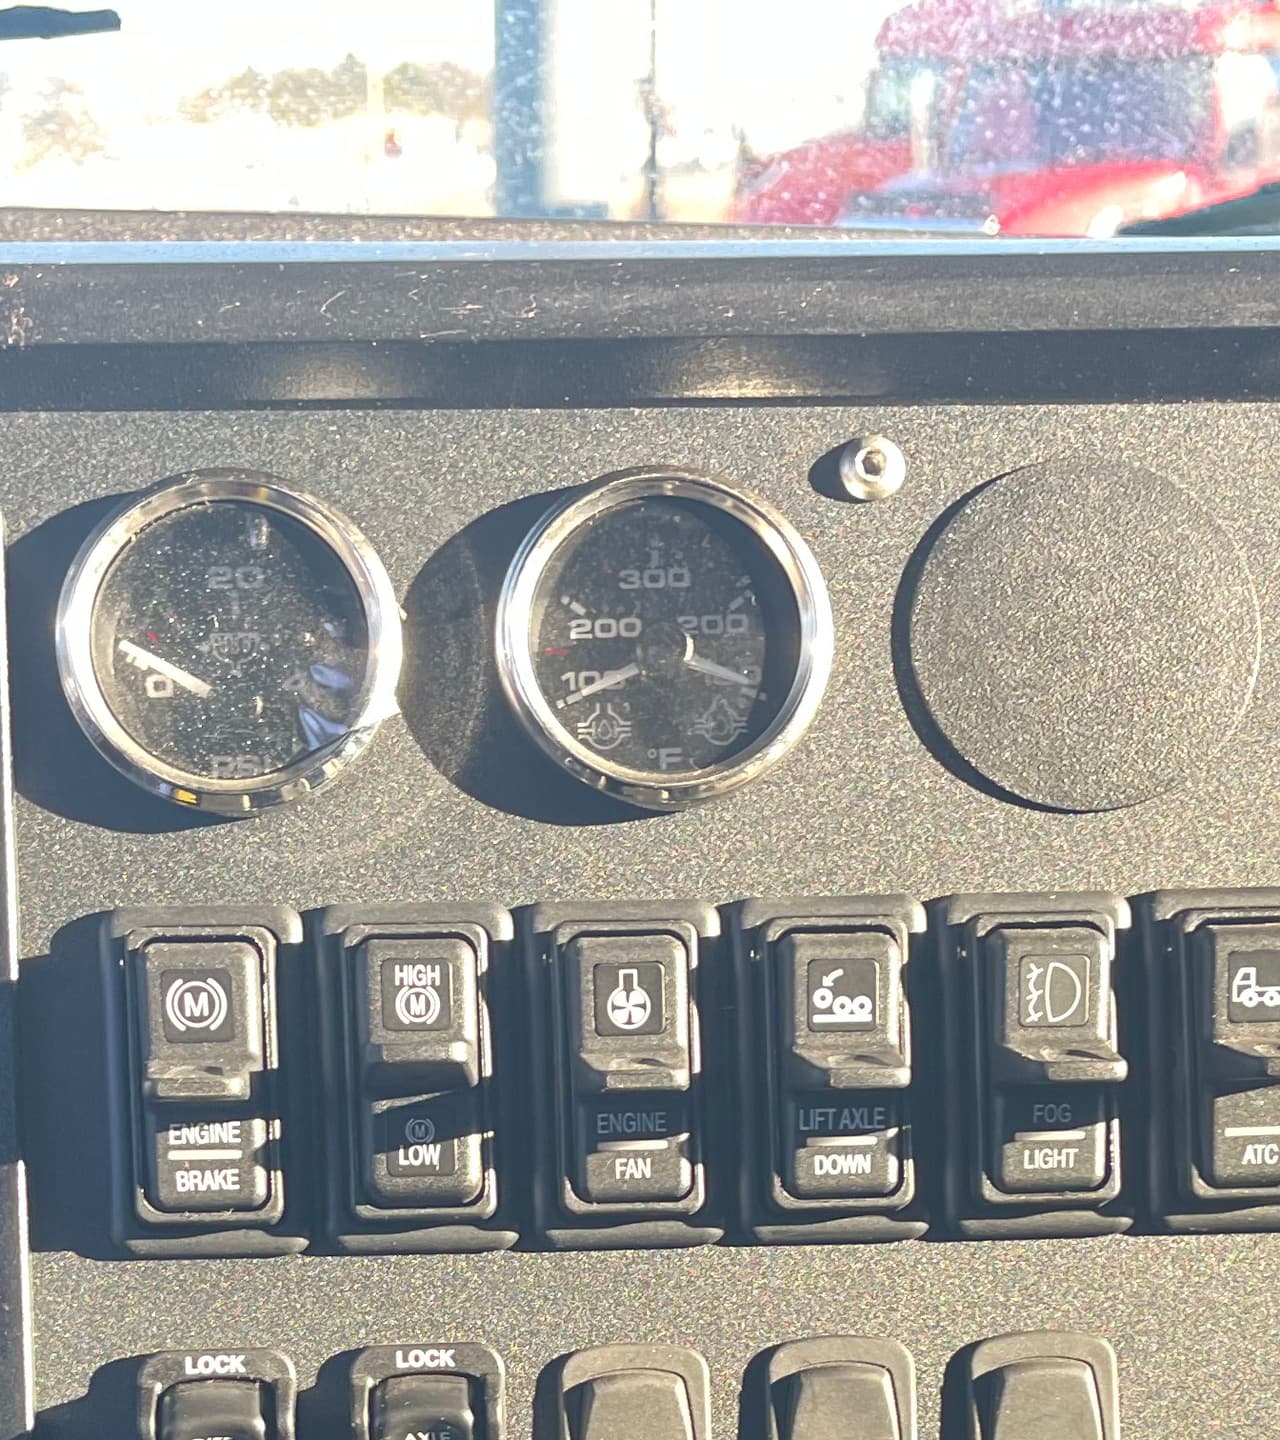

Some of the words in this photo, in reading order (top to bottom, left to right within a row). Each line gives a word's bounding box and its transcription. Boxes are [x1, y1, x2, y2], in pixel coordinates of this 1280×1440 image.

[619, 569, 691, 589] 300
[569, 617, 642, 639] 200
[677, 614, 748, 634] 200
[394, 966, 440, 986] HIGH
[184, 993, 208, 1016] M
[597, 1112, 667, 1134] ENGINE
[800, 1109, 836, 1131] LIFT
[838, 1108, 885, 1130] AXLE
[1033, 1104, 1071, 1124] FOG
[169, 1123, 241, 1144] ENGINE
[398, 1146, 440, 1168] LOW
[814, 1154, 870, 1175] DOWN
[1023, 1148, 1078, 1170] LIGHT
[1241, 1144, 1279, 1166] ATC
[615, 1158, 651, 1180] FAN
[176, 1170, 240, 1191] BRAKE
[185, 1355, 246, 1375] LOCK
[396, 1349, 455, 1369] LOCK
